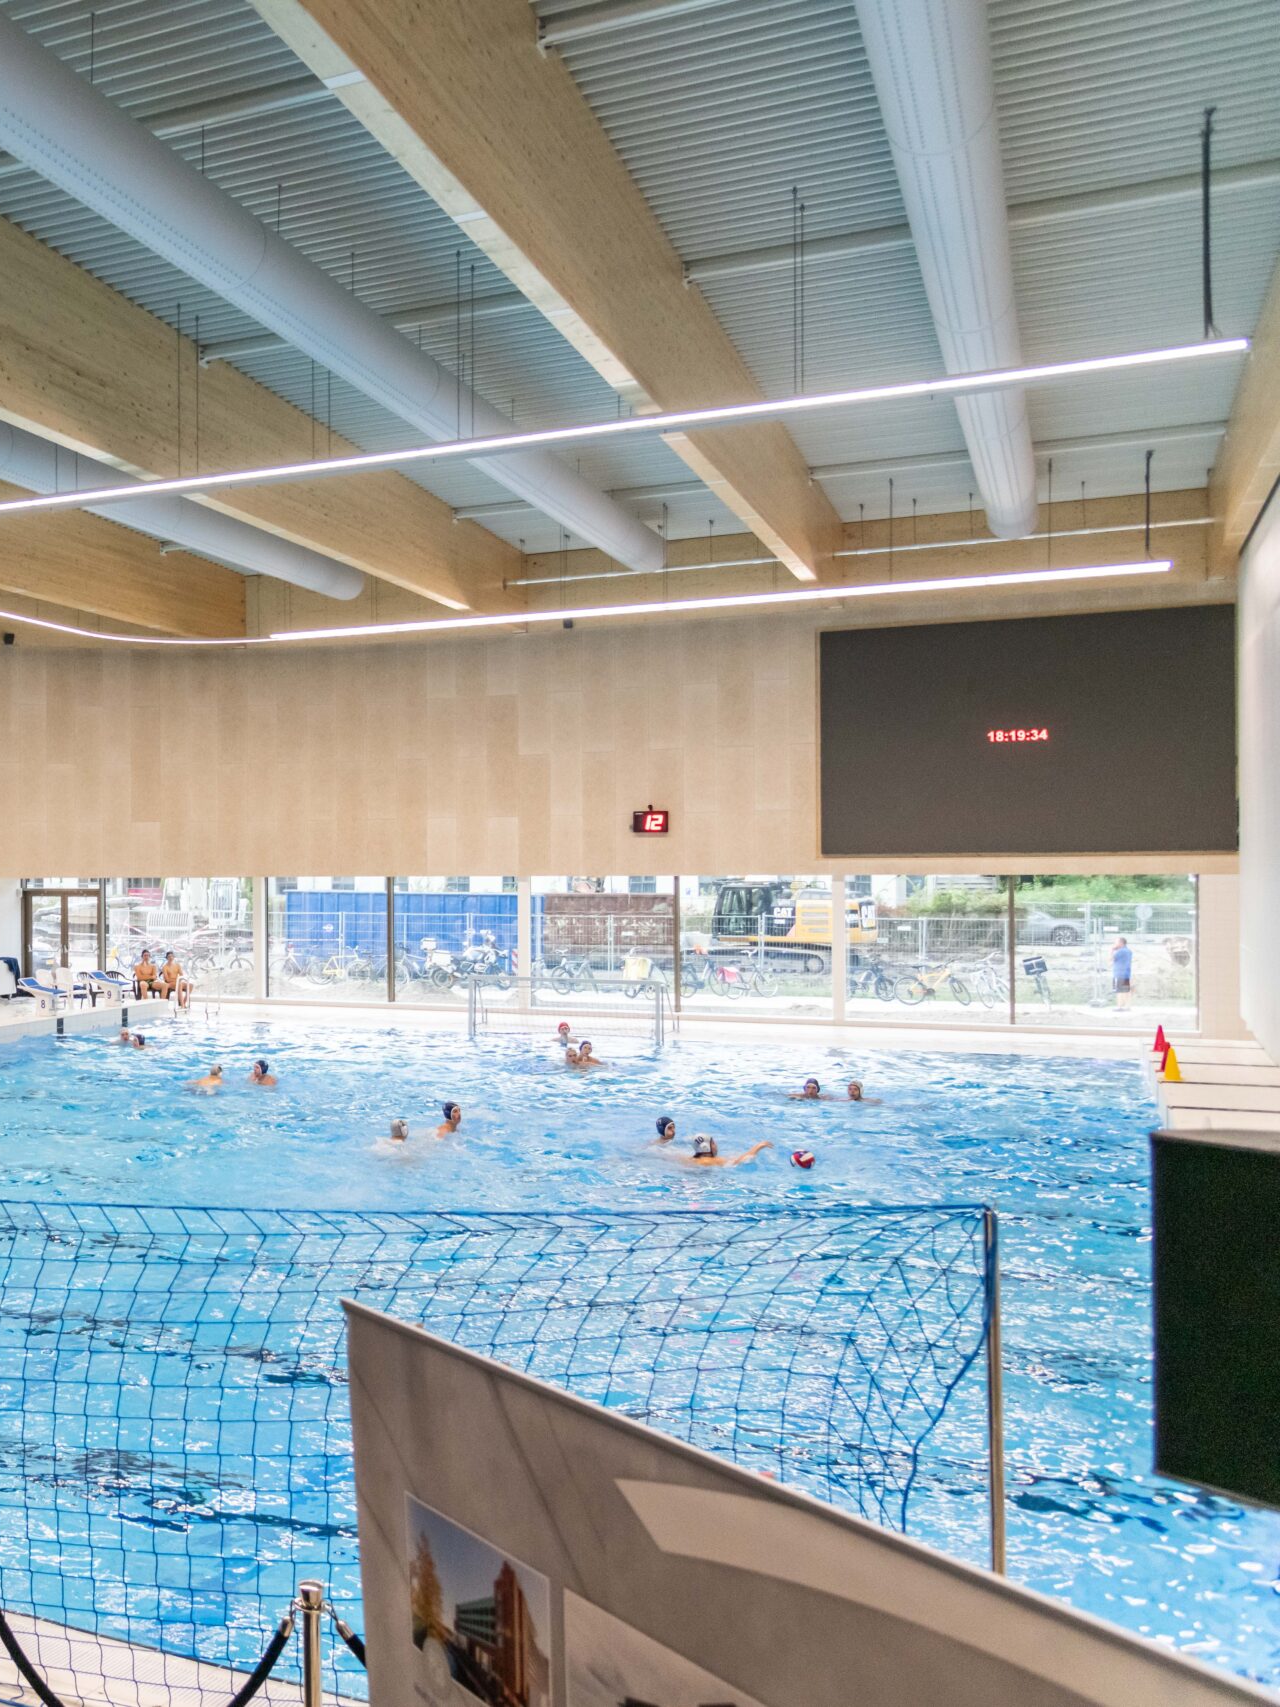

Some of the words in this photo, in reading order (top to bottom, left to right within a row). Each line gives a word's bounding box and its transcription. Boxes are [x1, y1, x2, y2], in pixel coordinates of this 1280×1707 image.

[987, 729, 1048, 742] 18:19:34
[645, 814, 663, 831] 12
[773, 907, 793, 918] CAT
[107, 990, 112, 999] 9
[40, 999, 46, 1009] 8
[694, 1135, 704, 1145] 10
